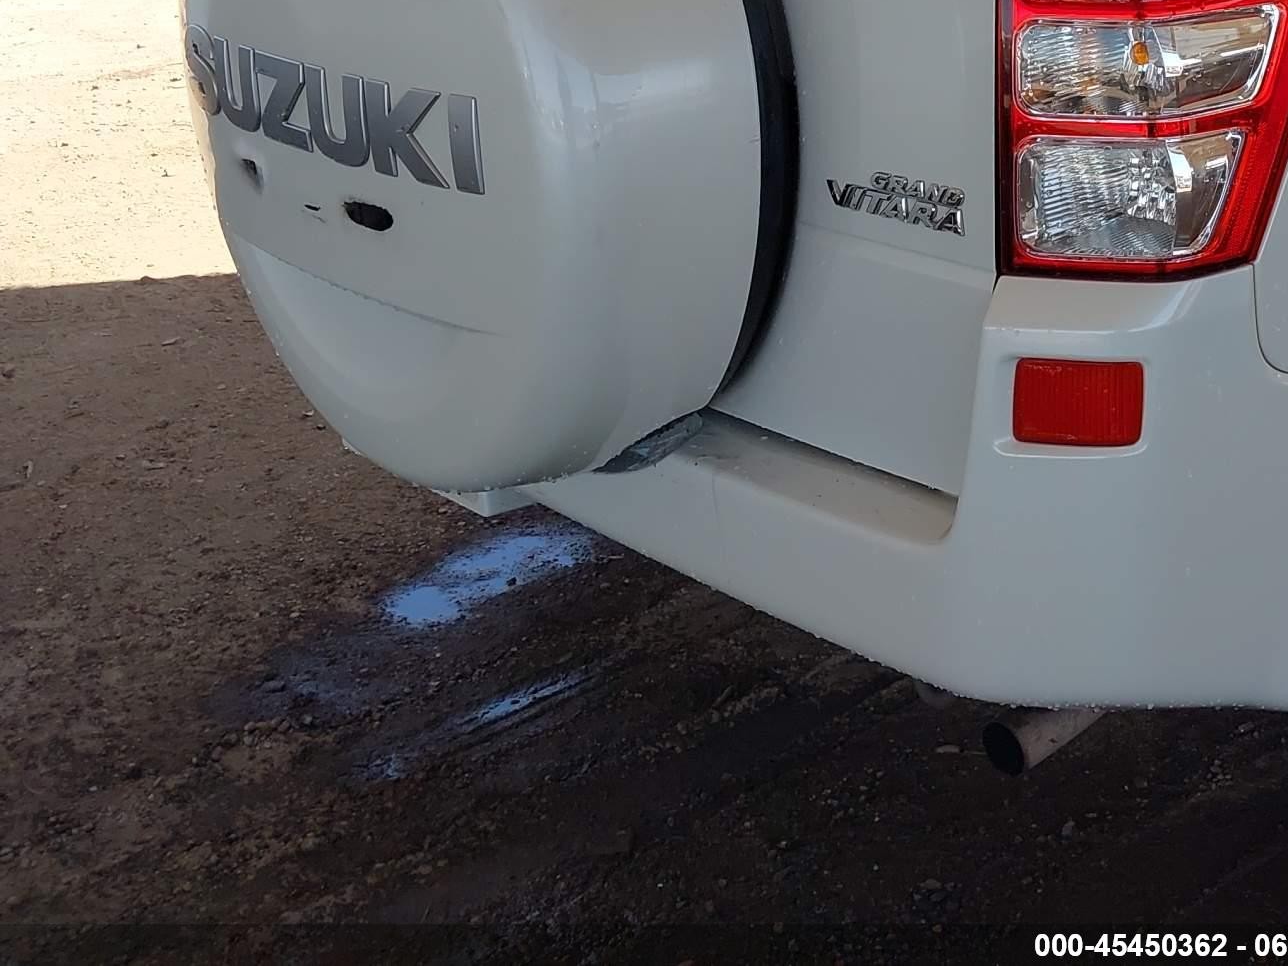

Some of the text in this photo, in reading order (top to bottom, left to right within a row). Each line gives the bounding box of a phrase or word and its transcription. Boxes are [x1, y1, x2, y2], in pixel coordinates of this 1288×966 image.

[185, 24, 485, 195] SUZUKI
[826, 179, 966, 237] VITARA
[870, 171, 966, 208] GRAND
